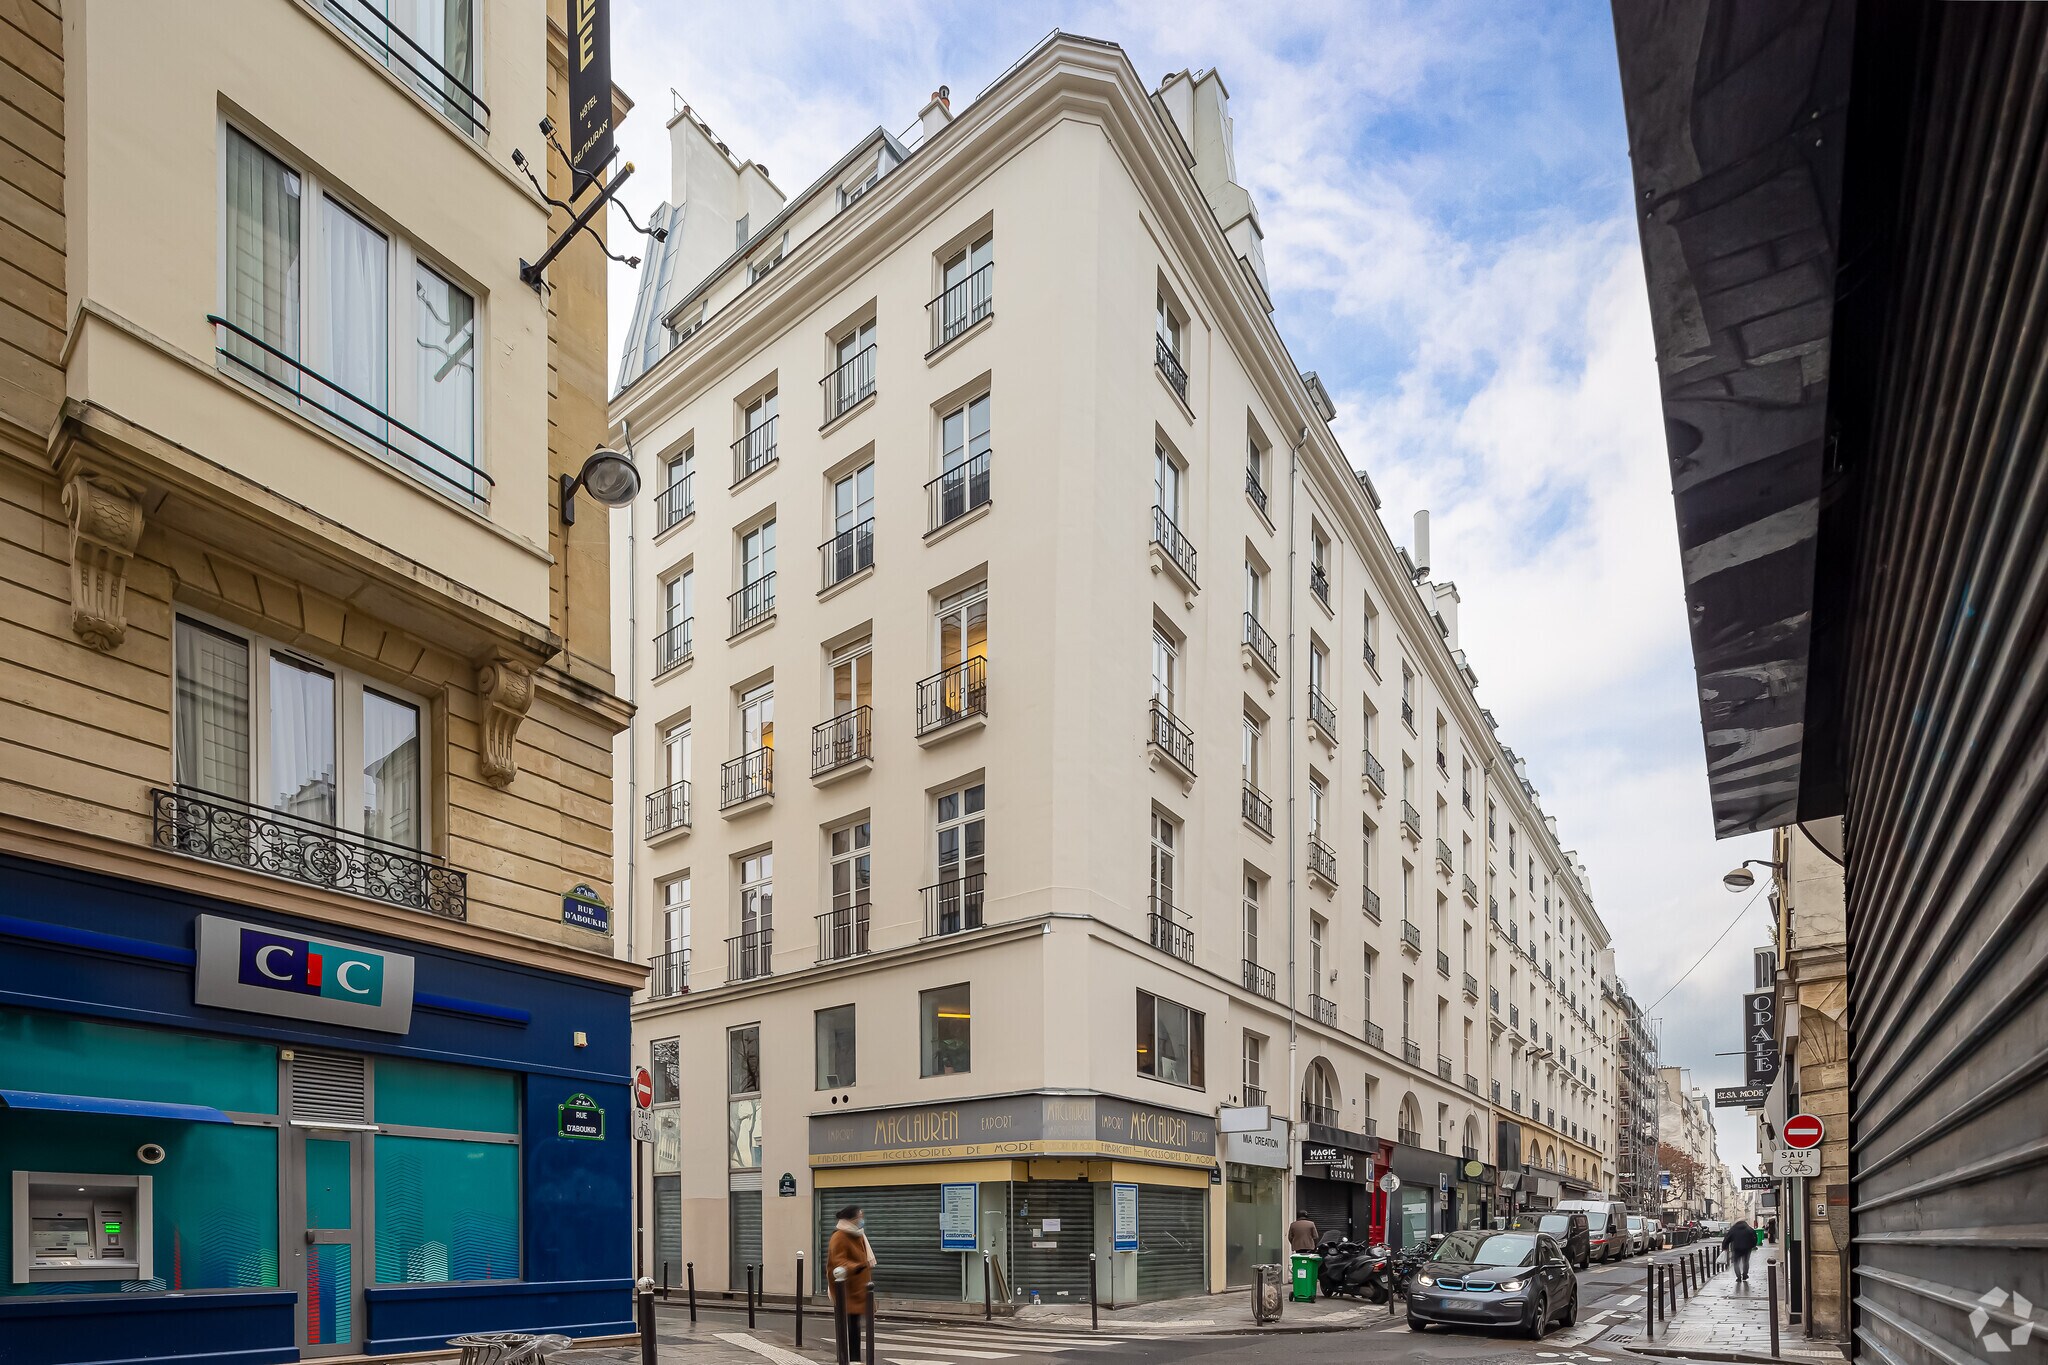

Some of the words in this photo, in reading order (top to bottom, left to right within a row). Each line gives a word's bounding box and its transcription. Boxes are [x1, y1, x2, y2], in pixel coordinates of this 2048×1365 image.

[573, 119, 608, 166] RESTAURANT
[577, 905, 594, 915] RUE
[565, 911, 607, 929] D'ABOUKIR
[1751, 996, 1773, 1072] OPALE
[1740, 1089, 1764, 1098] MODE
[575, 1111, 588, 1119] RUE
[638, 1110, 652, 1121] SAUF
[566, 1124, 597, 1134] D'ABOUKIR
[874, 1110, 959, 1145] MACLAUREN
[981, 1115, 1013, 1131] EXPORT
[1101, 1114, 1124, 1130] IMPORT
[1130, 1111, 1187, 1147] MACLAUREN
[1243, 1134, 1252, 1144] MIA
[1255, 1136, 1278, 1148] CREATION
[817, 1153, 862, 1163] FABRICANT
[882, 1147, 952, 1159] ACCESSOIRES
[966, 1145, 981, 1155] DE
[994, 1141, 1035, 1153] MODE
[1144, 1149, 1181, 1161] ACCESSOIRES
[1331, 1170, 1354, 1179] CUSTOM
